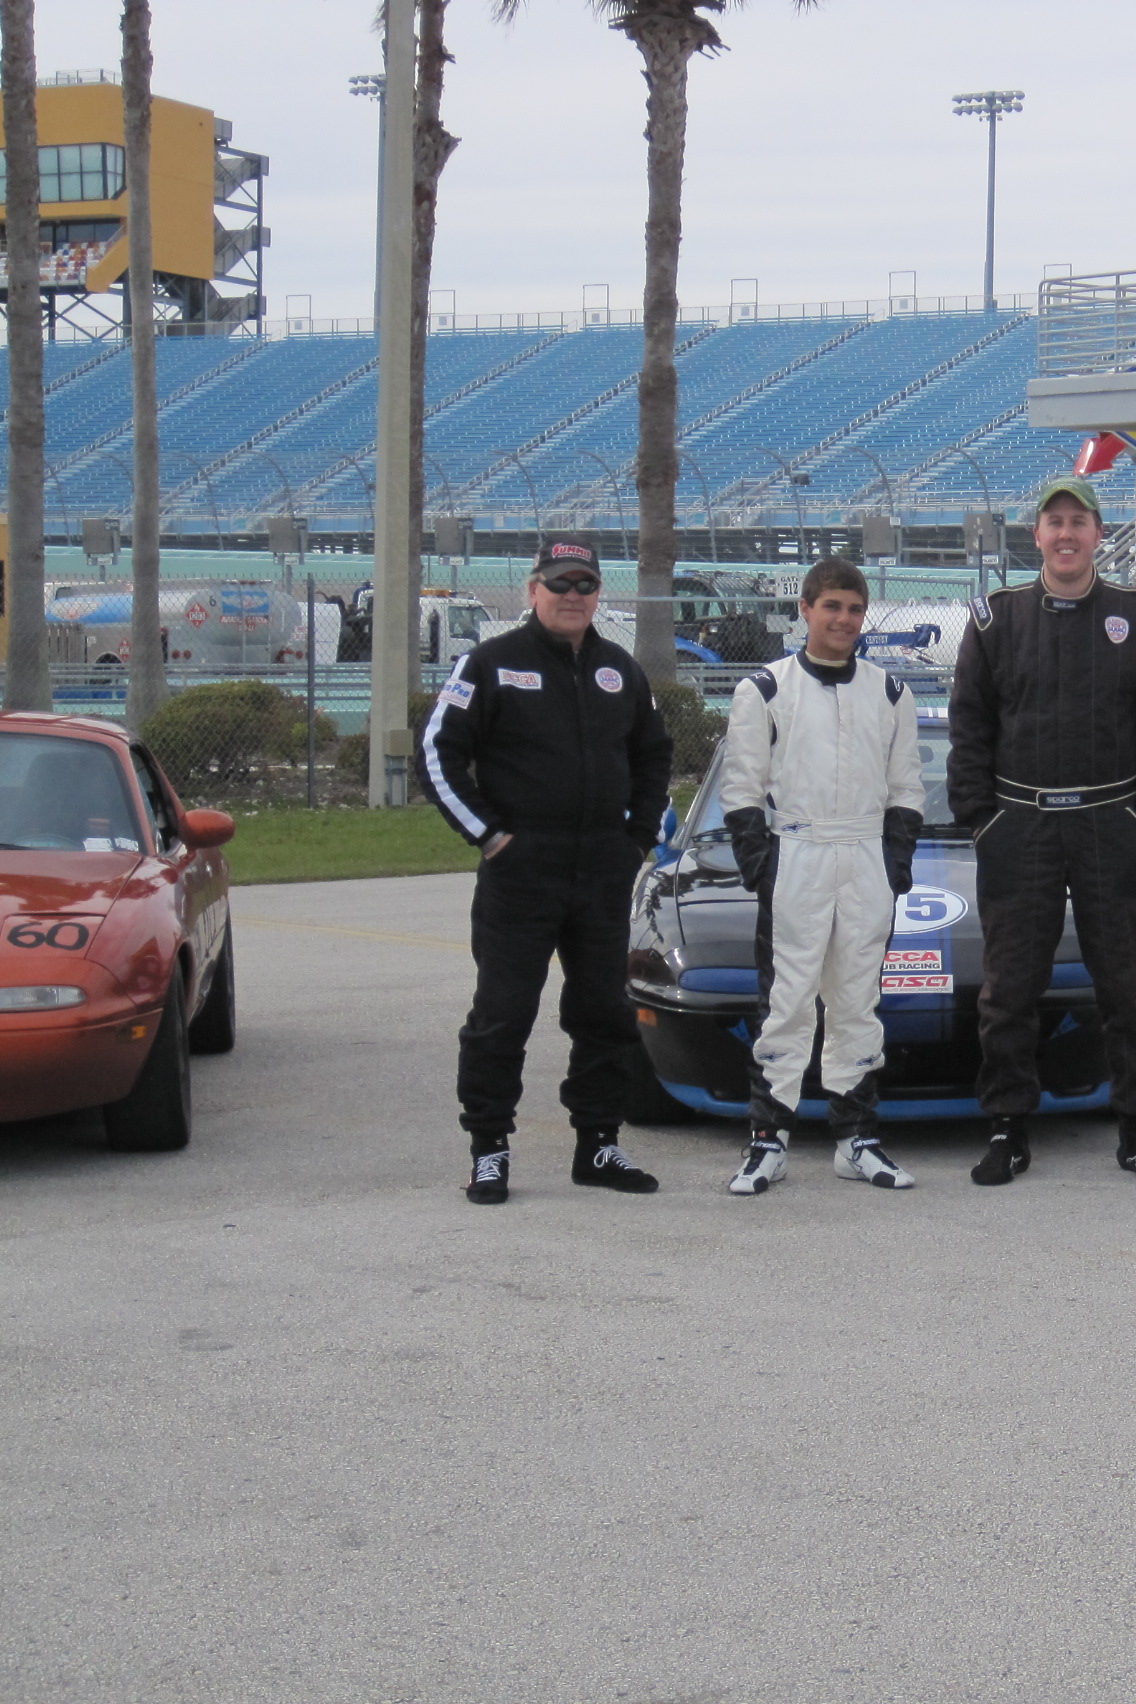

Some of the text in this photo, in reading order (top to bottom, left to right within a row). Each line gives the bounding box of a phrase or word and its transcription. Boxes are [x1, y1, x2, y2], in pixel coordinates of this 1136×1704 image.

[783, 583, 798, 595] 512
[209, 595, 217, 607] 6
[6, 922, 90, 951] 60
[884, 951, 940, 962] CCA
[882, 976, 949, 988] asa
